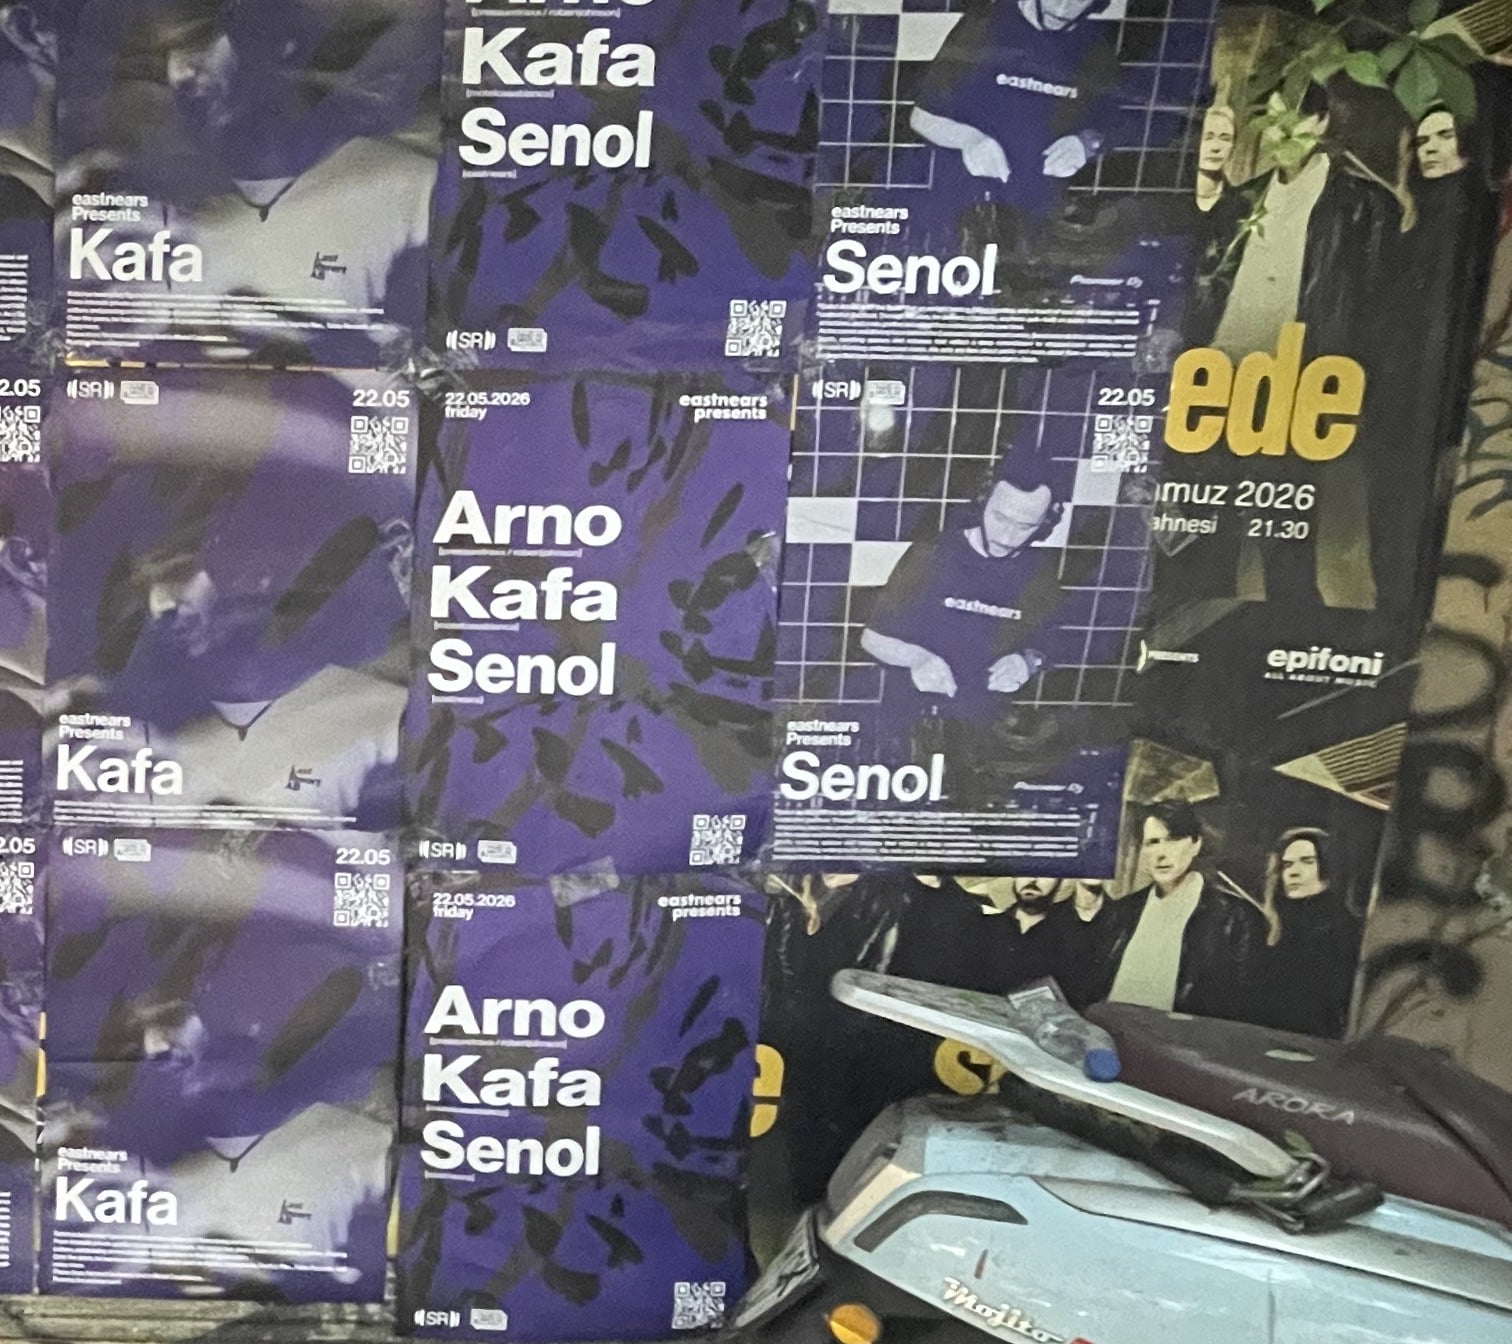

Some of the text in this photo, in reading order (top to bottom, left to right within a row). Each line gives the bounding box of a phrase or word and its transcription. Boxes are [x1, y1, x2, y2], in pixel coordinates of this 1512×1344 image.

[462, 27, 655, 87] Kafa
[996, 72, 1078, 99] eastnears
[458, 106, 654, 169] Senol
[72, 193, 148, 209] eastnears
[72, 207, 141, 222] Presents
[831, 205, 908, 220] eastnears
[830, 220, 900, 235] Presents
[70, 228, 202, 283] Kafa
[823, 240, 998, 297] Senol
[458, 332, 484, 349] SR
[79, 381, 103, 397] SR
[824, 381, 849, 399] SR
[1098, 388, 1155, 406] 22.05
[352, 389, 410, 408] 22.05
[444, 392, 531, 407] 22.05.2026
[679, 393, 768, 408] eastnears
[444, 406, 488, 421] friday
[694, 406, 767, 423] presents
[1234, 480, 1315, 510] 2026
[432, 489, 622, 547] Arno
[1247, 517, 1309, 540] 21.30
[430, 565, 617, 621] Kafa
[428, 638, 616, 695] Senol
[1266, 646, 1384, 675] epifoni
[59, 713, 131, 727] eastnears
[786, 719, 860, 733] eastnears
[59, 726, 124, 741] Presents
[786, 732, 852, 746] Presents
[57, 743, 183, 795] Kafa
[780, 751, 944, 802] Senol
[74, 839, 98, 855] SR
[431, 841, 455, 859] SR
[336, 848, 391, 866] 22.05
[433, 892, 516, 907] 22.05.2026
[658, 894, 741, 907] eastnears
[433, 906, 474, 920] friday
[672, 906, 741, 921] presents
[424, 985, 605, 1038] Arno
[422, 1054, 601, 1108] Kafa
[1232, 1088, 1354, 1125] ARORA
[420, 1120, 600, 1176] Senol
[58, 1158, 122, 1173] Presents
[55, 1176, 177, 1226] Kafa
[426, 1310, 451, 1327] SR
[943, 1277, 1065, 1344] Mojito
